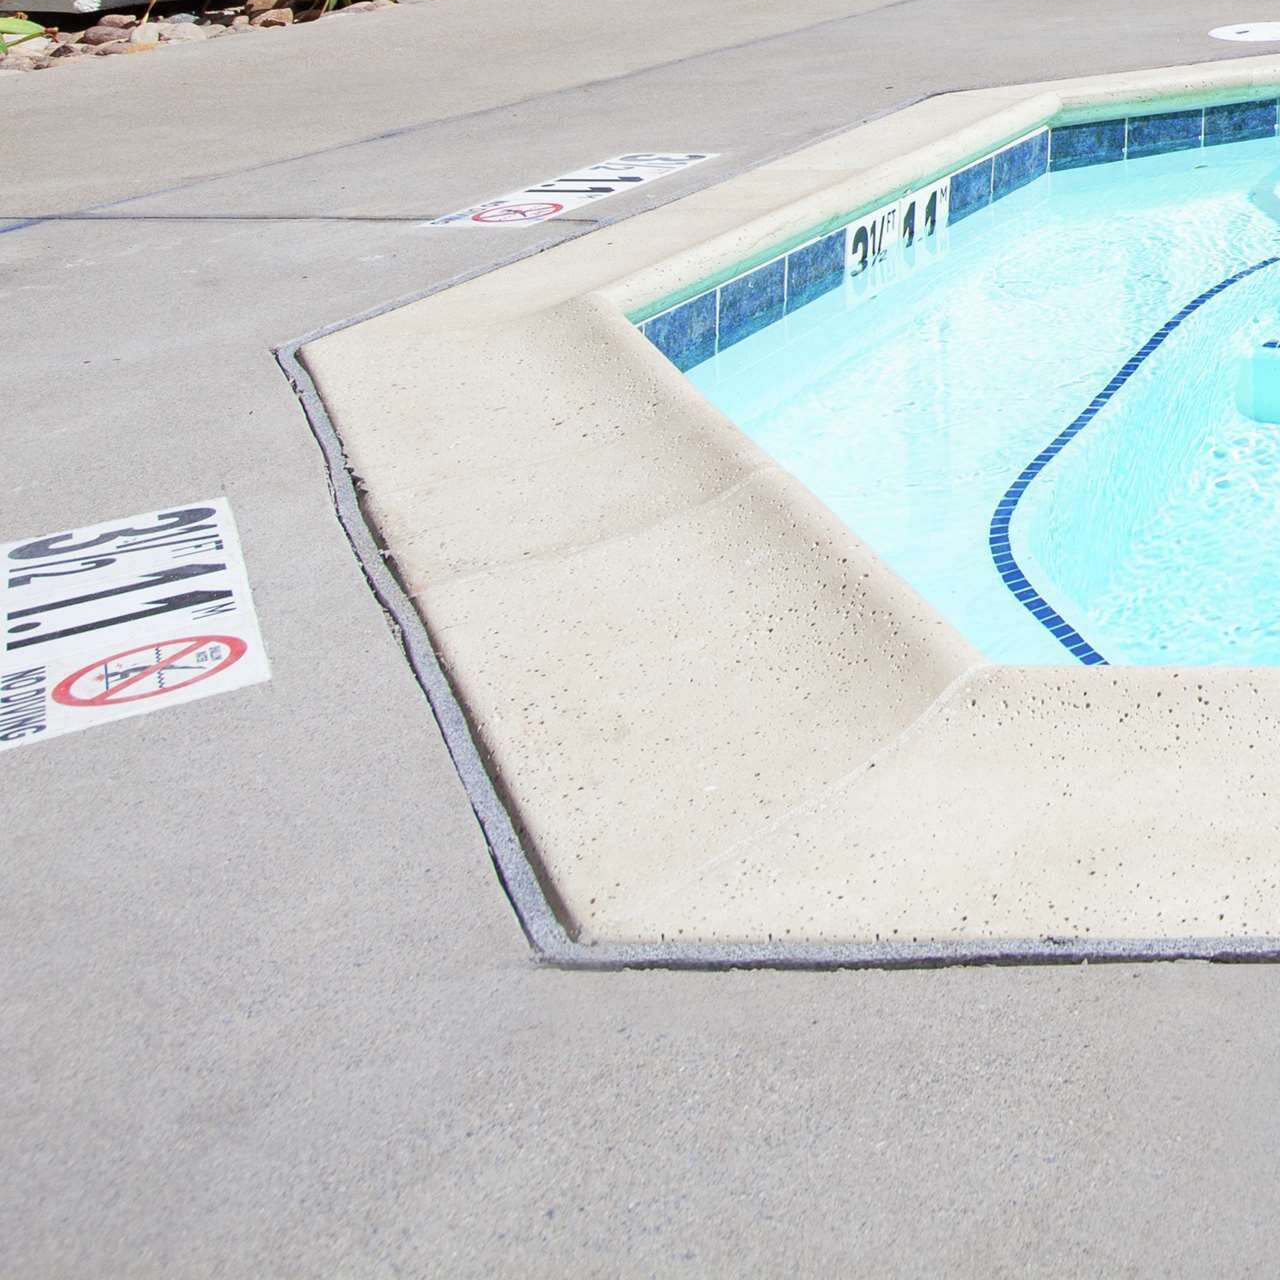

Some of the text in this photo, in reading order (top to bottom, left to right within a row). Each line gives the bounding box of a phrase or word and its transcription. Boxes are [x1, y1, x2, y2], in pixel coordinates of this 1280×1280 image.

[6, 563, 234, 652] 1.1
[0, 666, 47, 742] NO DIVING
